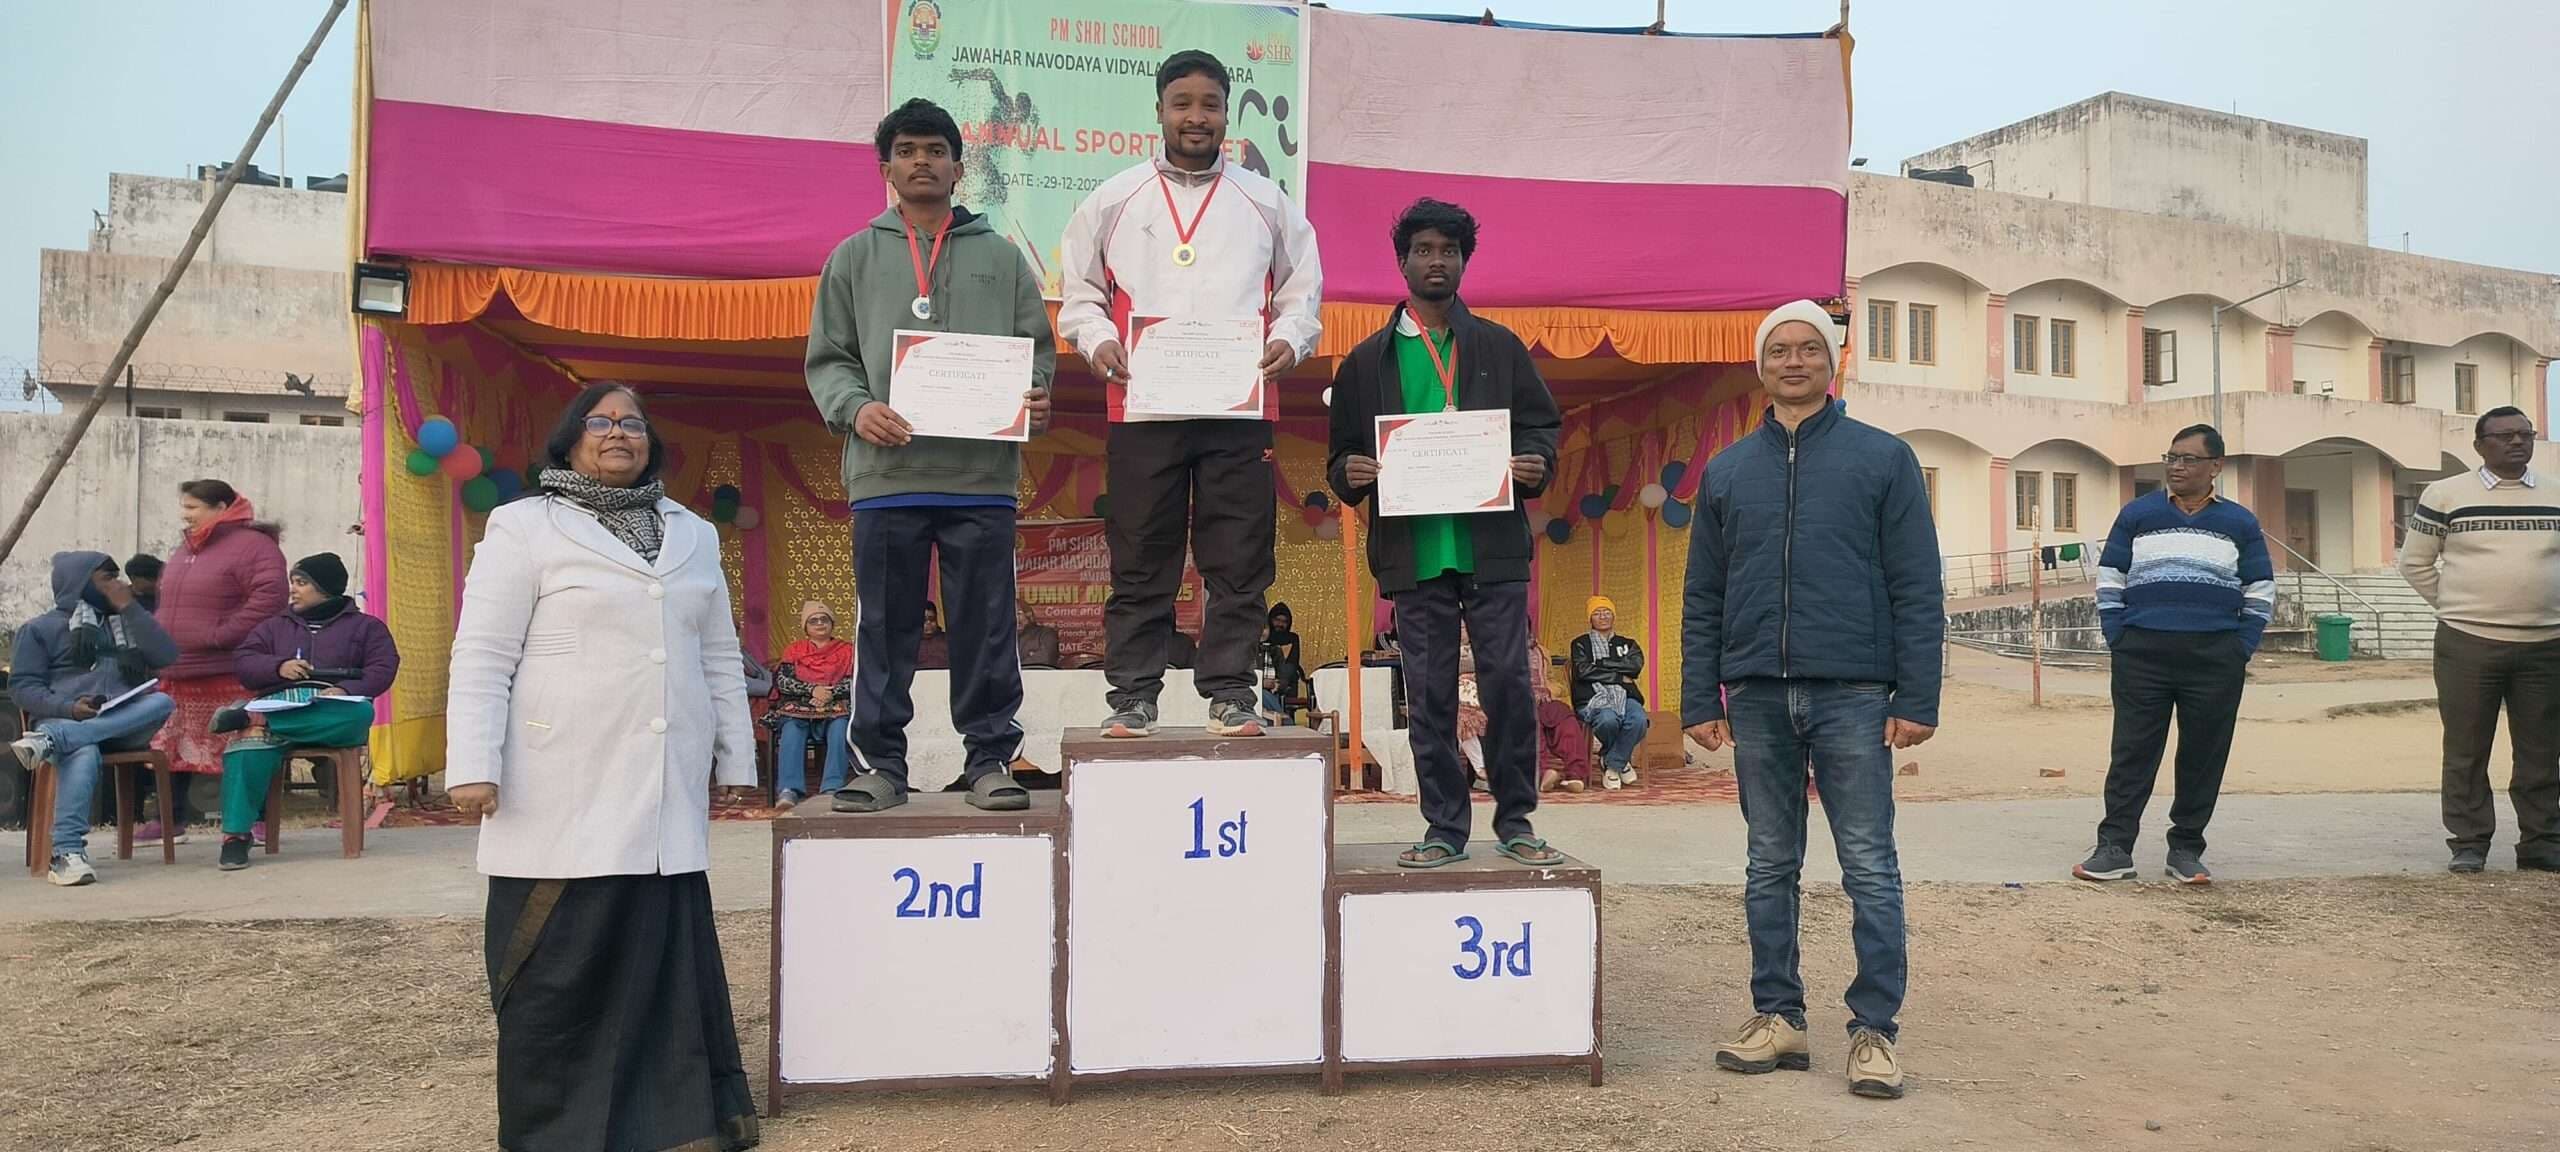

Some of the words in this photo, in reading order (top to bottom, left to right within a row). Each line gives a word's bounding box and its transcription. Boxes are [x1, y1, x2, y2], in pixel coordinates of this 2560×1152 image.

[1051, 17, 1069, 42] PM
[1076, 19, 1106, 46] SHRI
[1113, 23, 1162, 49] SCHOOL
[952, 46, 1022, 66] JAWAHAR
[1025, 51, 1101, 73] NAVODAYA
[1224, 66, 1254, 84] ARA
[960, 120, 1065, 152] ANNUAL
[1075, 128, 1164, 158] SPORT
[1219, 138, 1249, 163] ET
[1002, 172, 1034, 188] DATE
[1412, 447, 1469, 458] CERTIFICATE
[1048, 537, 1067, 553] PM
[1044, 606, 1077, 617] Come
[1080, 606, 1102, 616] and
[1184, 796, 1248, 859] 1st
[893, 862, 984, 918] 2nd
[1452, 915, 1532, 979] 3rd
